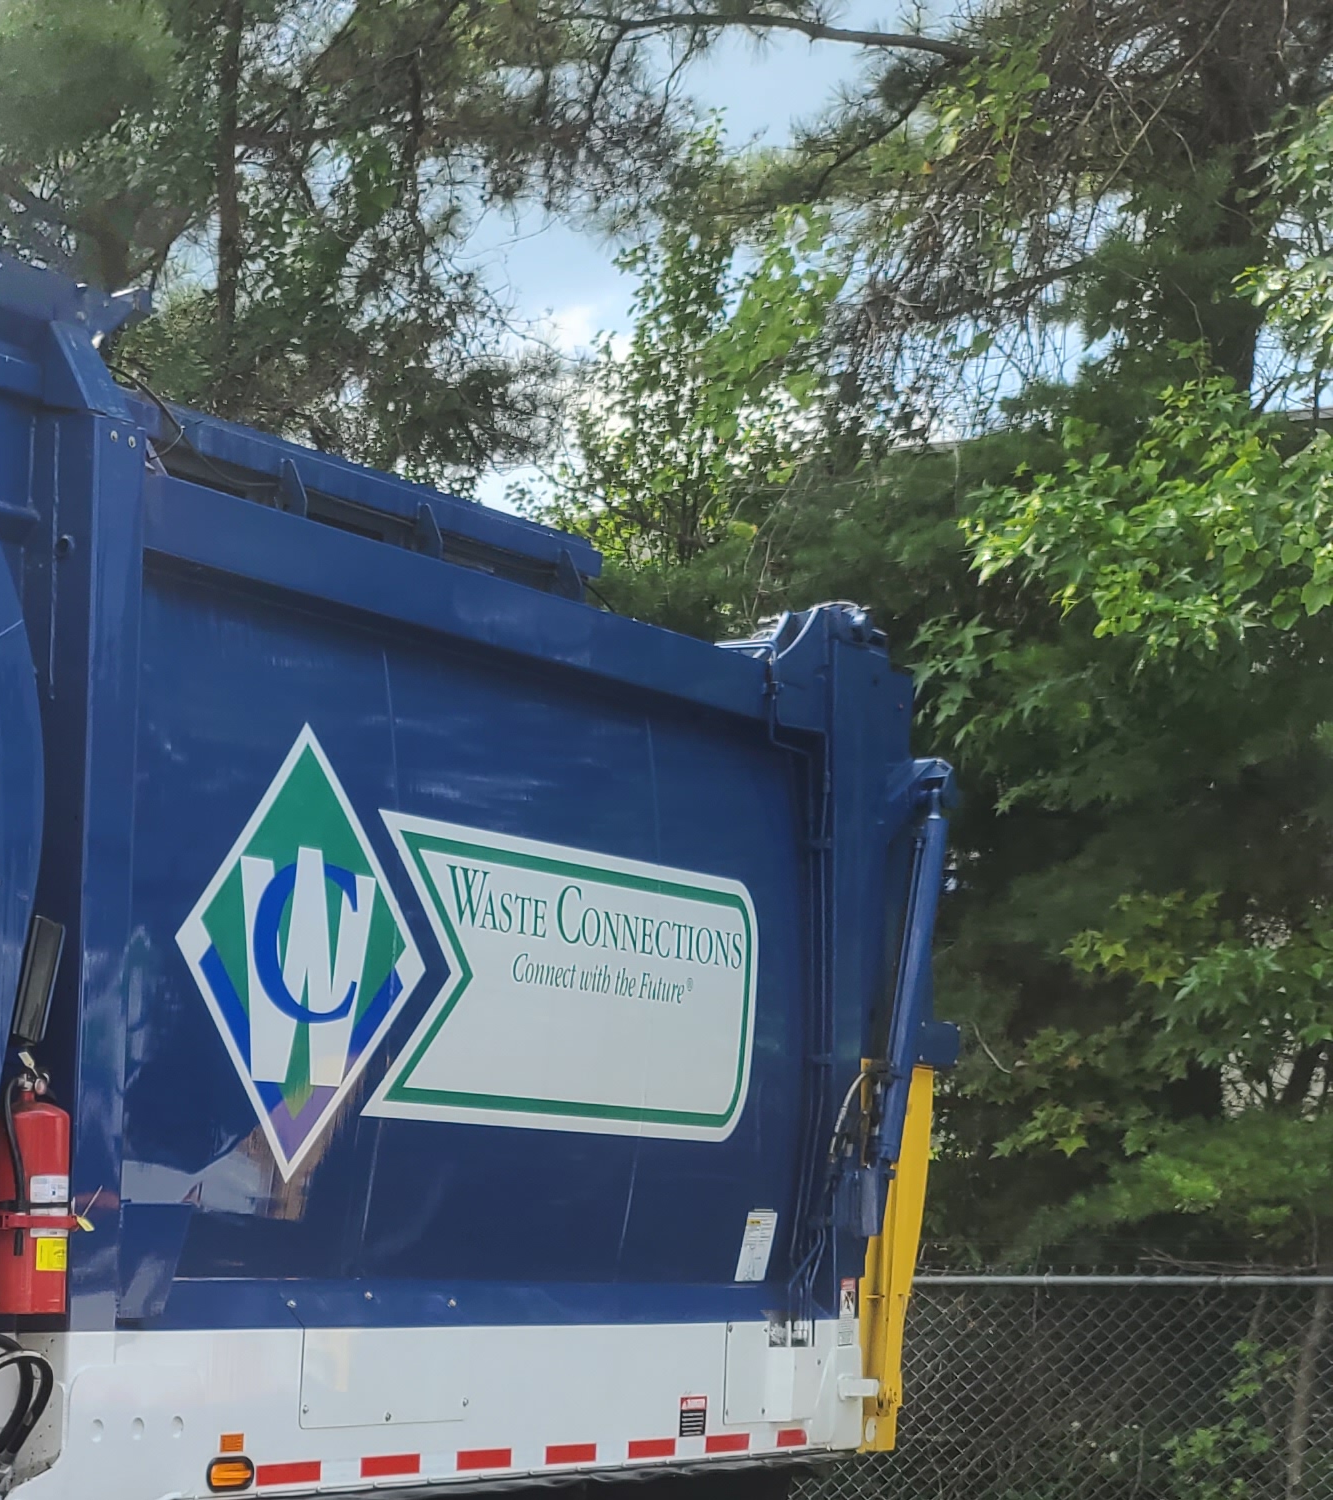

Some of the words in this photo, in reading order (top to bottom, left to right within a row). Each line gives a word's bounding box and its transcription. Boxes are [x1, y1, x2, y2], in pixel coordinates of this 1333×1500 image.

[446, 863, 547, 939] WASTE
[556, 885, 743, 969] CONNECTIONS
[512, 953, 577, 990] Connect
[579, 964, 610, 995] with
[614, 967, 636, 998] the
